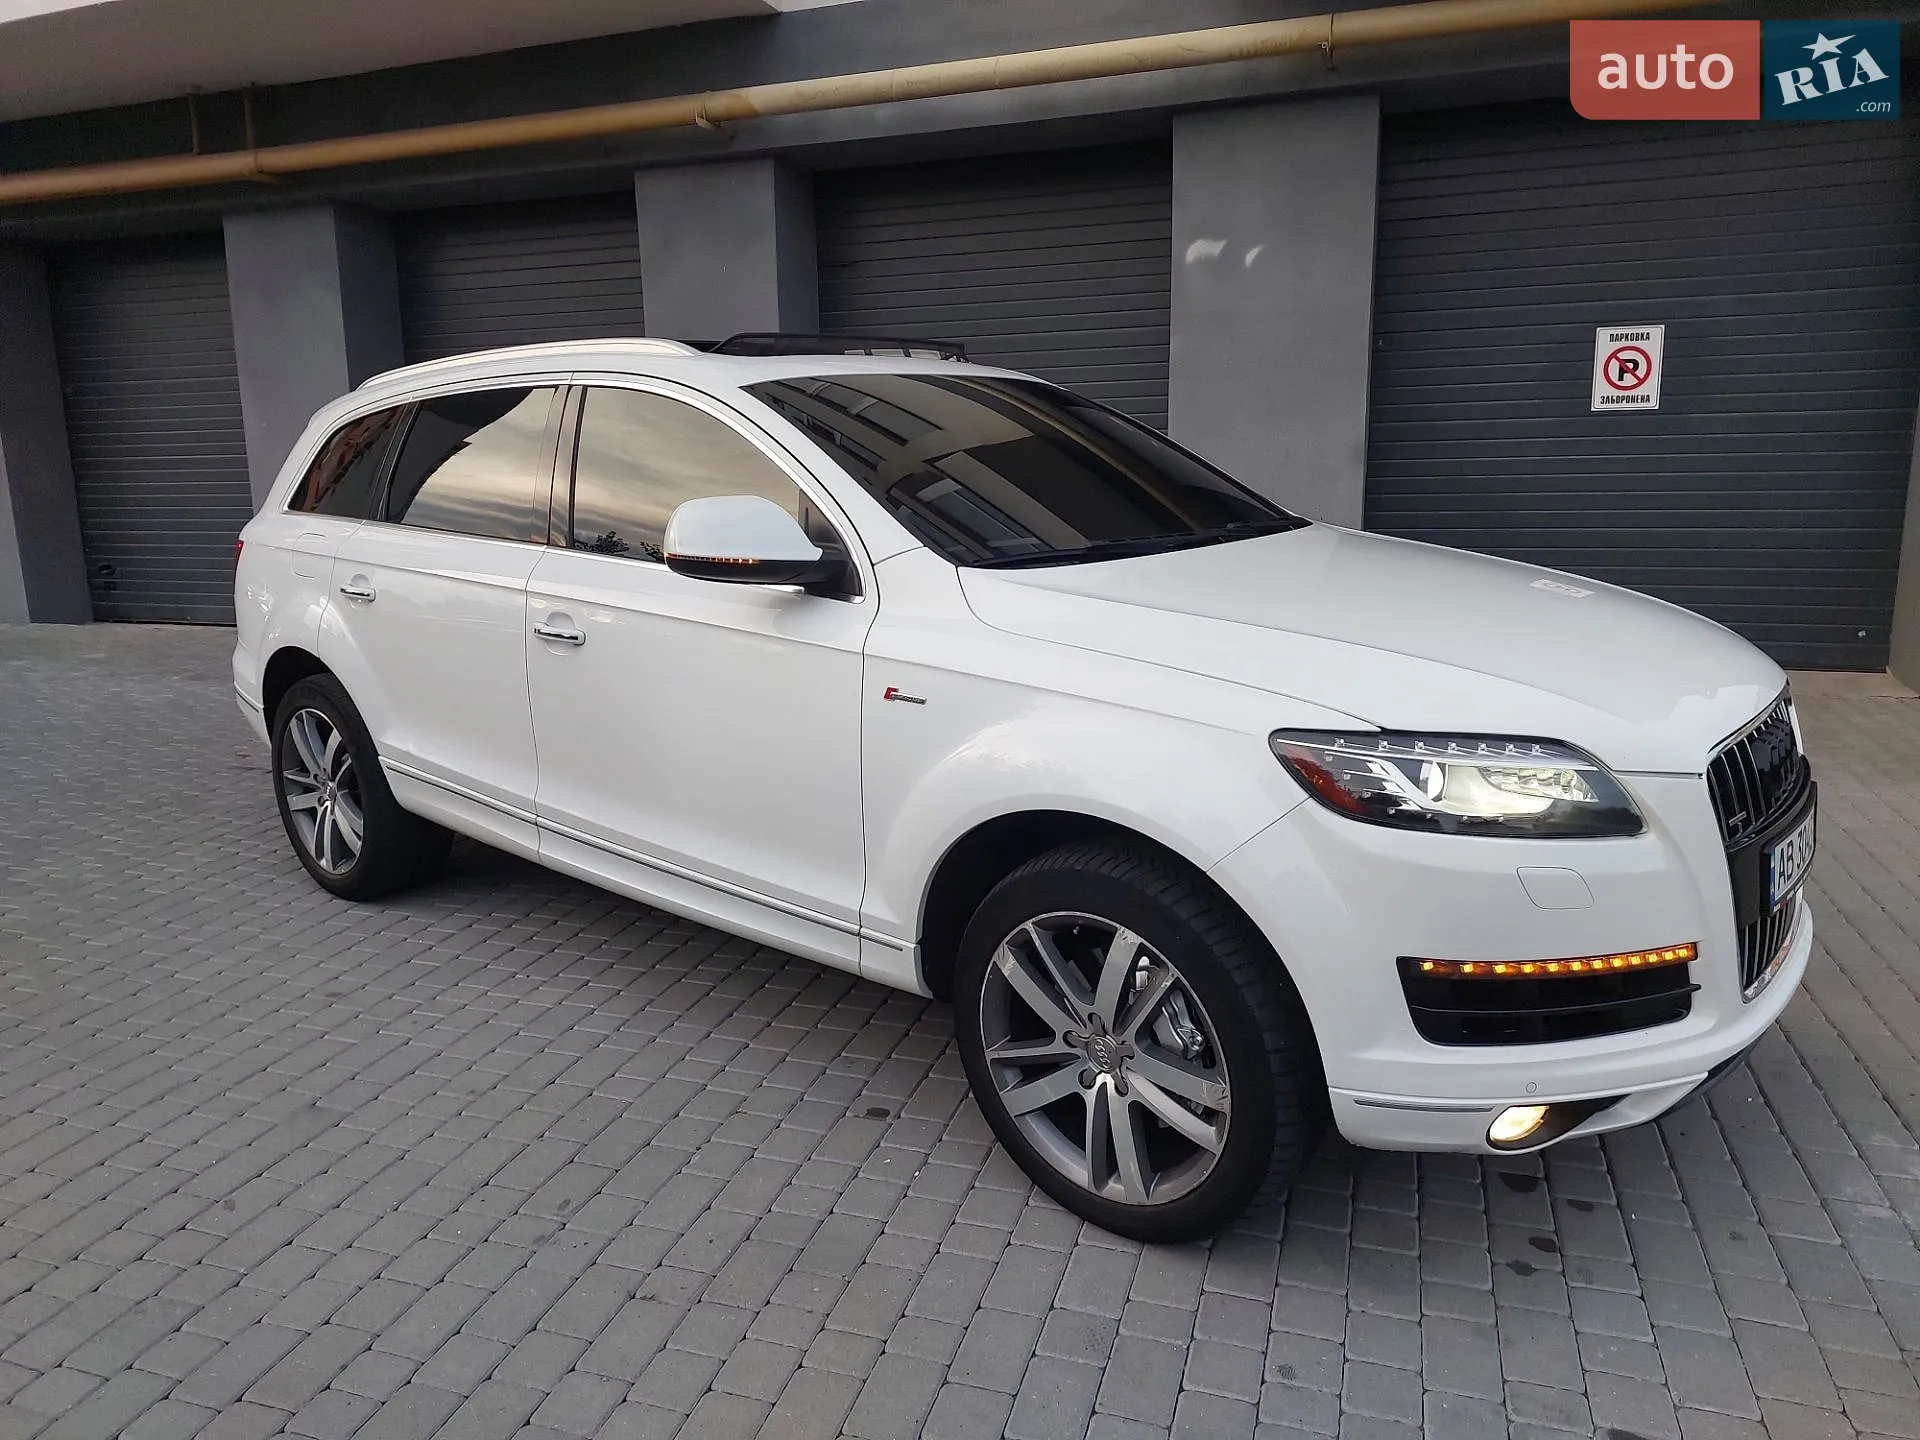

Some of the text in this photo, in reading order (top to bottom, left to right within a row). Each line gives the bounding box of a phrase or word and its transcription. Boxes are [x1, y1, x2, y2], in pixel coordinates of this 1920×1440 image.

[1609, 332, 1650, 343] ПАРКОВКА
[1600, 394, 1650, 405] ЗАБОРОНЕНА
[1777, 839, 1794, 891] AB
